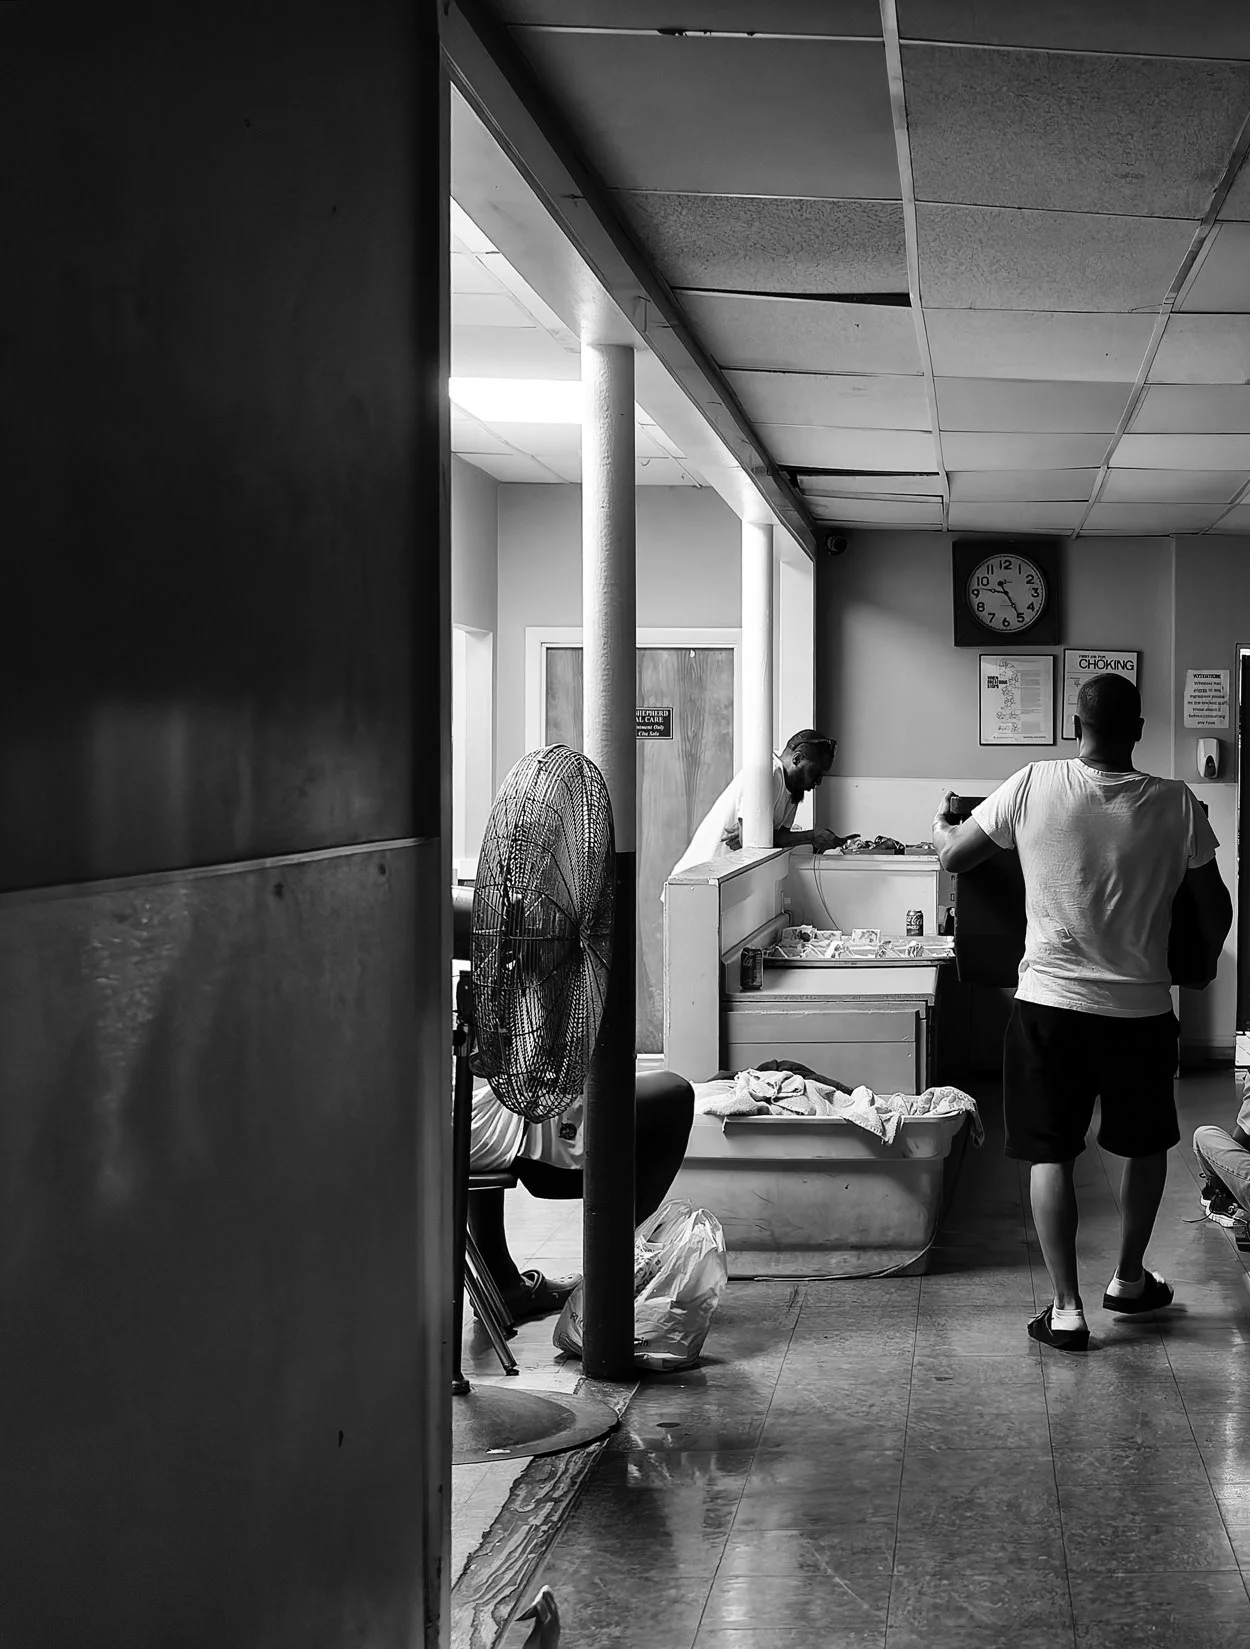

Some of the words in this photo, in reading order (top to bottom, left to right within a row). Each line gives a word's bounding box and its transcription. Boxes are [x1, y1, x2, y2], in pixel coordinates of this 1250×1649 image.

[986, 563, 994, 575] 11
[999, 559, 1013, 570] 12
[976, 576, 990, 587] 10
[1025, 574, 1035, 585] 2
[971, 588, 980, 599] 9
[1030, 587, 1040, 598] 3
[976, 601, 985, 612] 8
[1026, 601, 1036, 612] 4
[987, 612, 996, 623] 7
[1001, 617, 1011, 628] 6
[1016, 612, 1025, 623] 5
[1078, 658, 1135, 671] CHOKING
